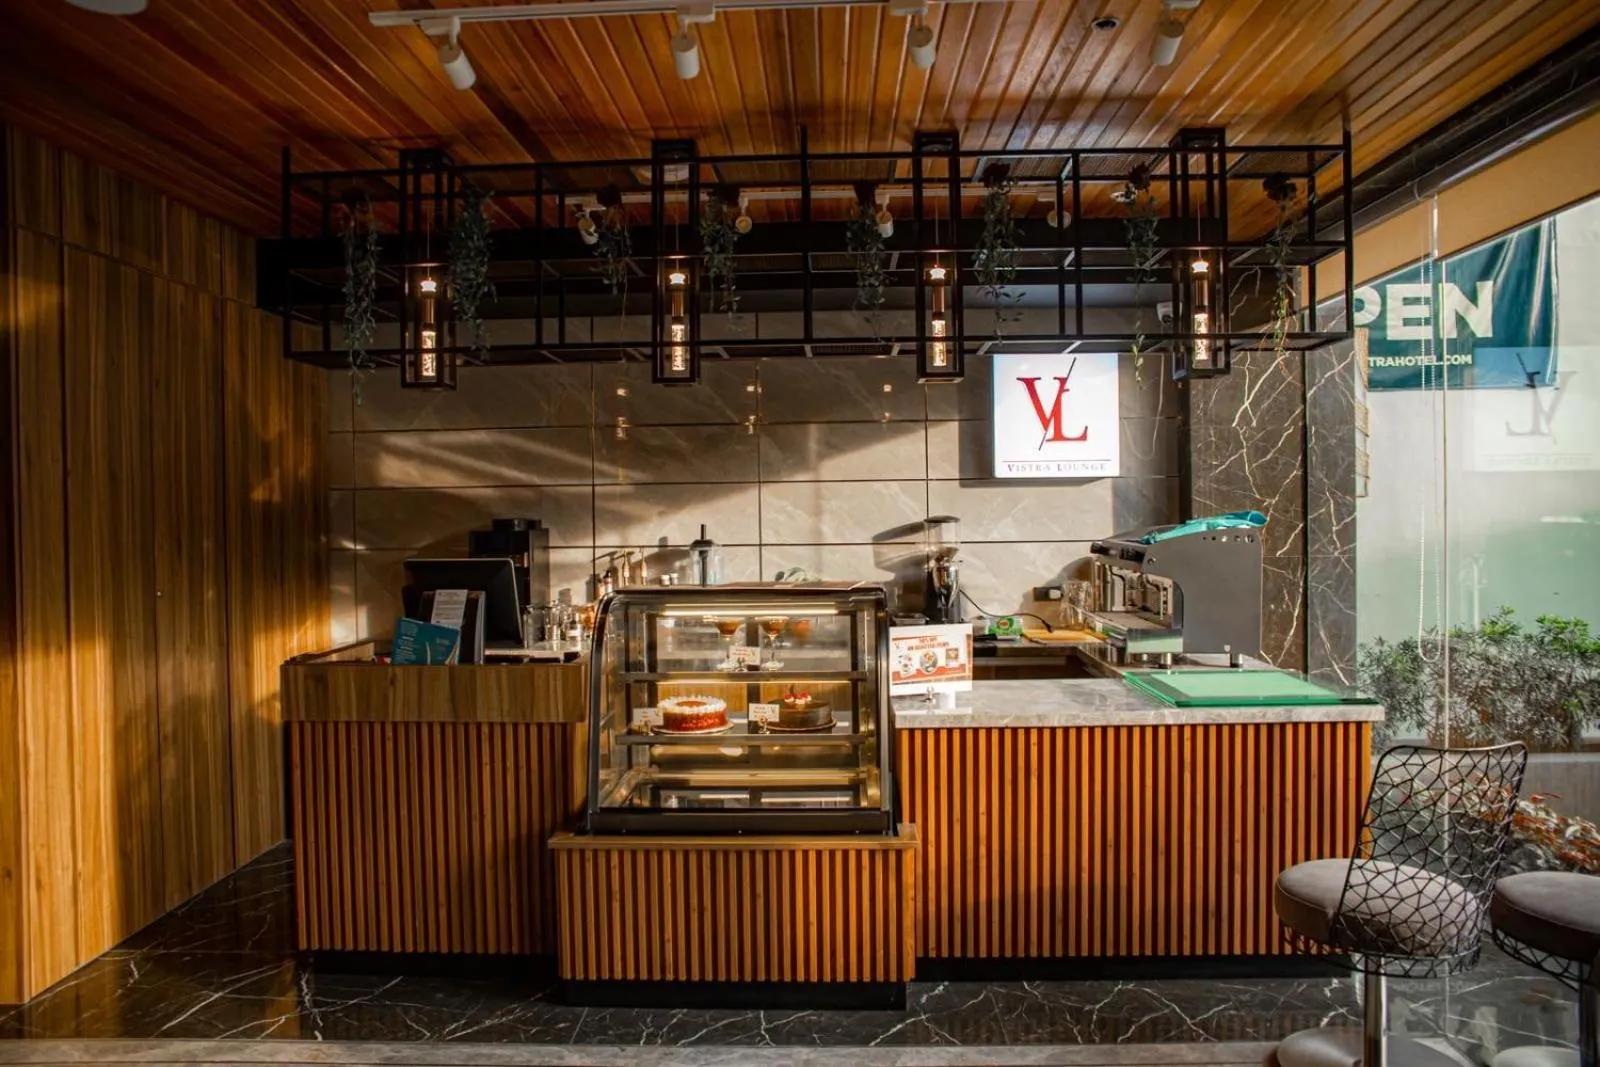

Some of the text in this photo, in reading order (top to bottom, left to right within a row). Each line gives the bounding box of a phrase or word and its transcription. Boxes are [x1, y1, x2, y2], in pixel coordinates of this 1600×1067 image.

[1368, 354, 1473, 368] TRAHOTEL.COM
[1007, 463, 1107, 473] VISTRA LOUNGE
